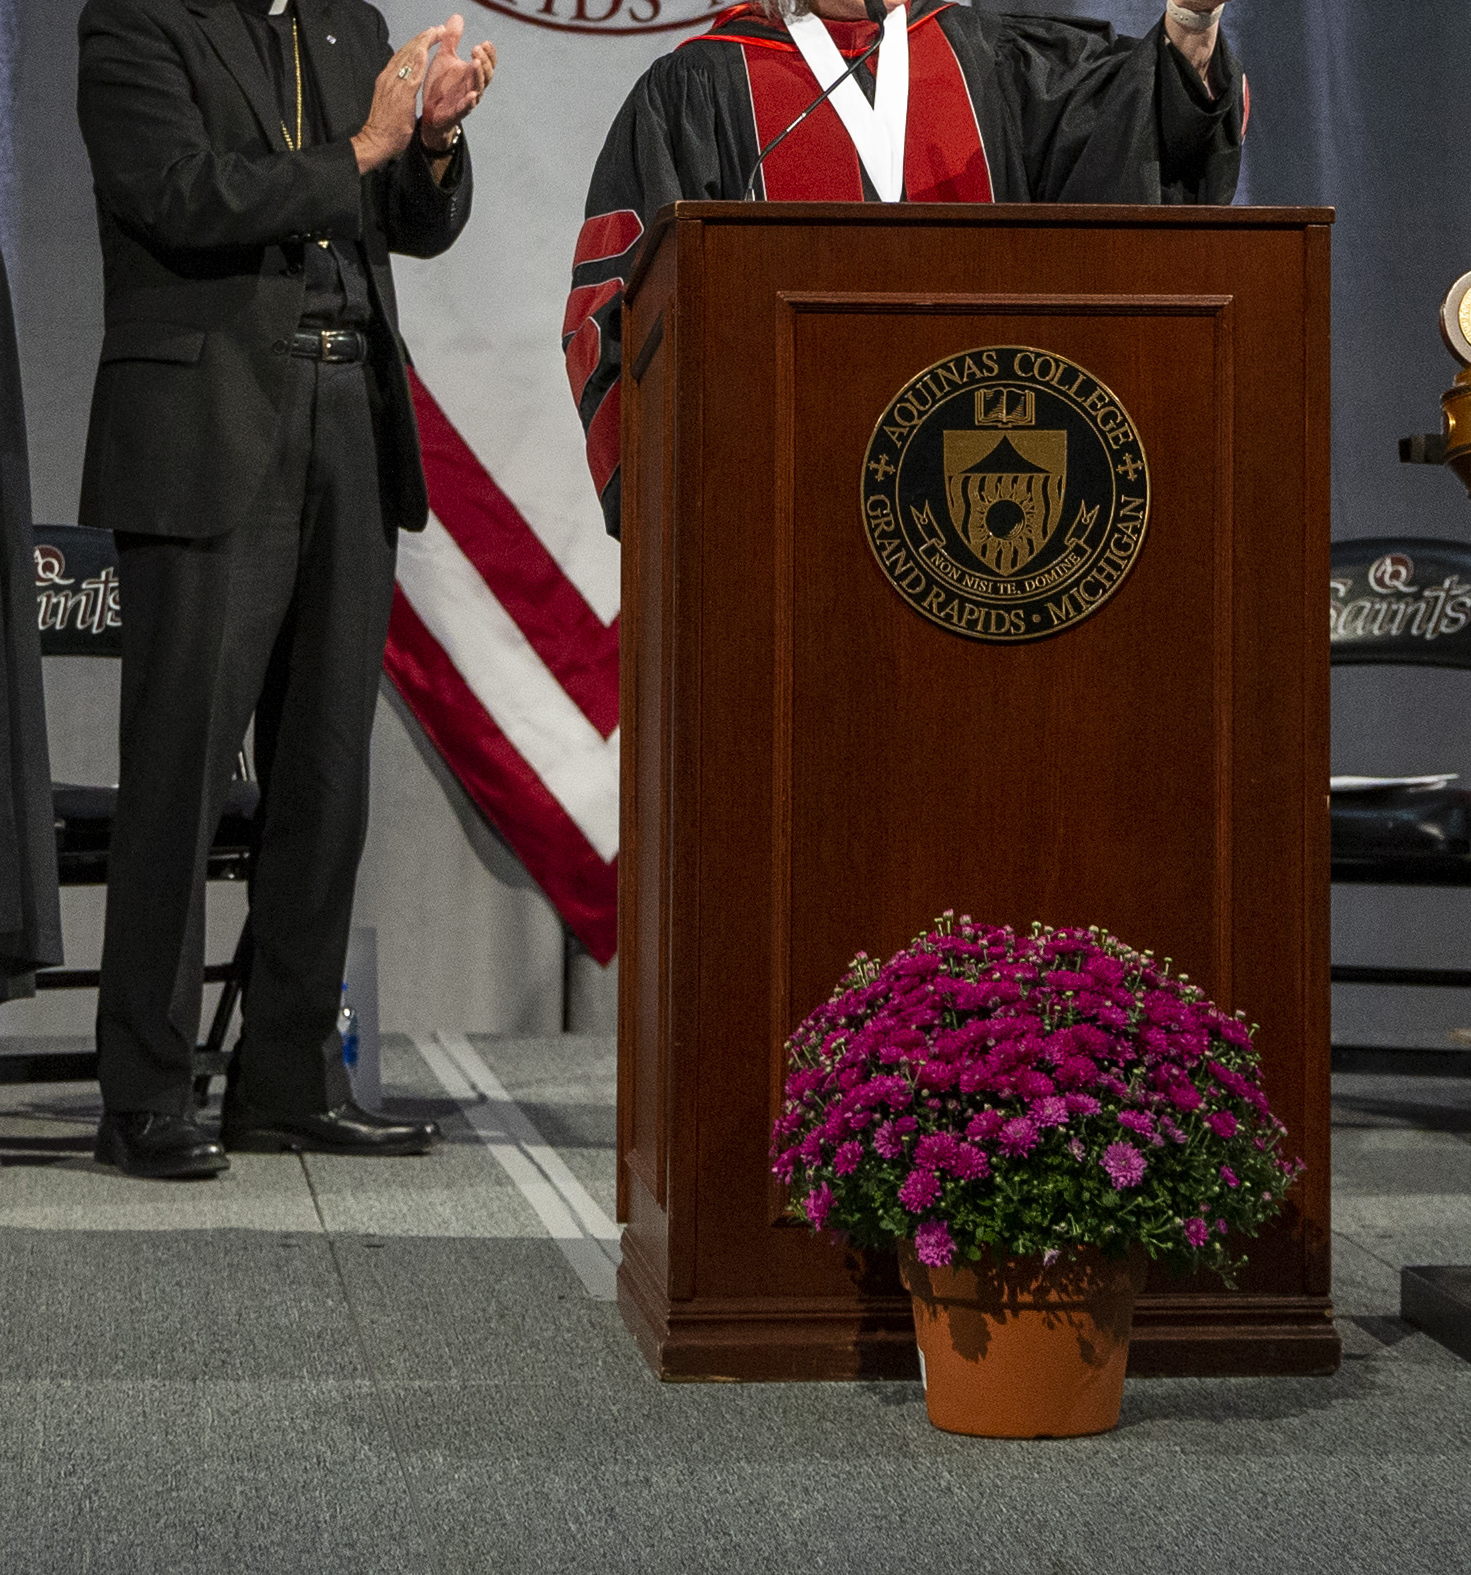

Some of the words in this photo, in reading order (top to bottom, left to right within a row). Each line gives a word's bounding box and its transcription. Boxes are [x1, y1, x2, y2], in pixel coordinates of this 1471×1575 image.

[882, 350, 1000, 449] AQUINAS
[1013, 351, 1135, 450] COLLEGE
[867, 494, 927, 595] GRAND
[921, 585, 1026, 635] RAPIDS
[1043, 494, 1145, 626] MICHIGAN
[930, 551, 959, 581] NON
[963, 573, 993, 595] NISI
[1025, 551, 1081, 592] DOMINE
